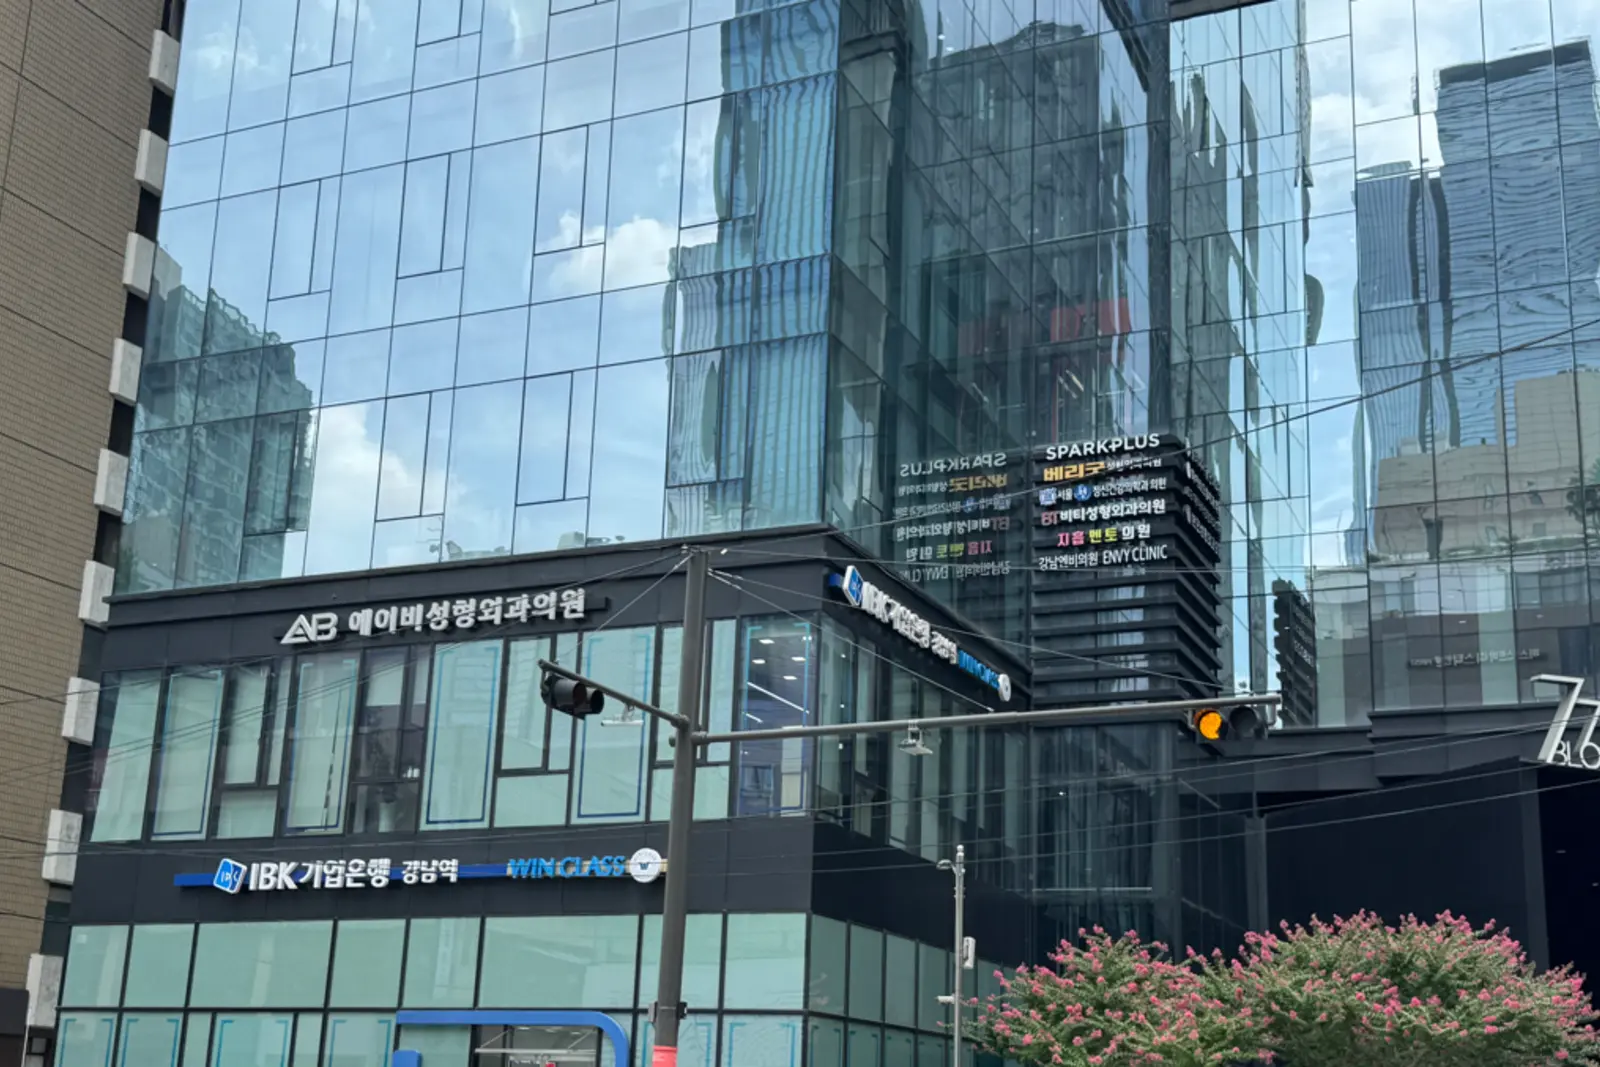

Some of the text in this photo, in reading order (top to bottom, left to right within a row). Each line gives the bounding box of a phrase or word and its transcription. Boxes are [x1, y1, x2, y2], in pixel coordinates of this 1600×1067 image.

[1046, 433, 1161, 461] SPARKPLUS
[1102, 549, 1130, 565] ENVY
[1132, 544, 1168, 562] CLINIC
[279, 588, 586, 645] AB 에이비성형외과의원
[249, 861, 299, 891] IBK
[299, 858, 392, 889] 기업은행
[401, 858, 459, 885] 강남역
[508, 857, 556, 879] WIN
[558, 855, 626, 878] CLASS
